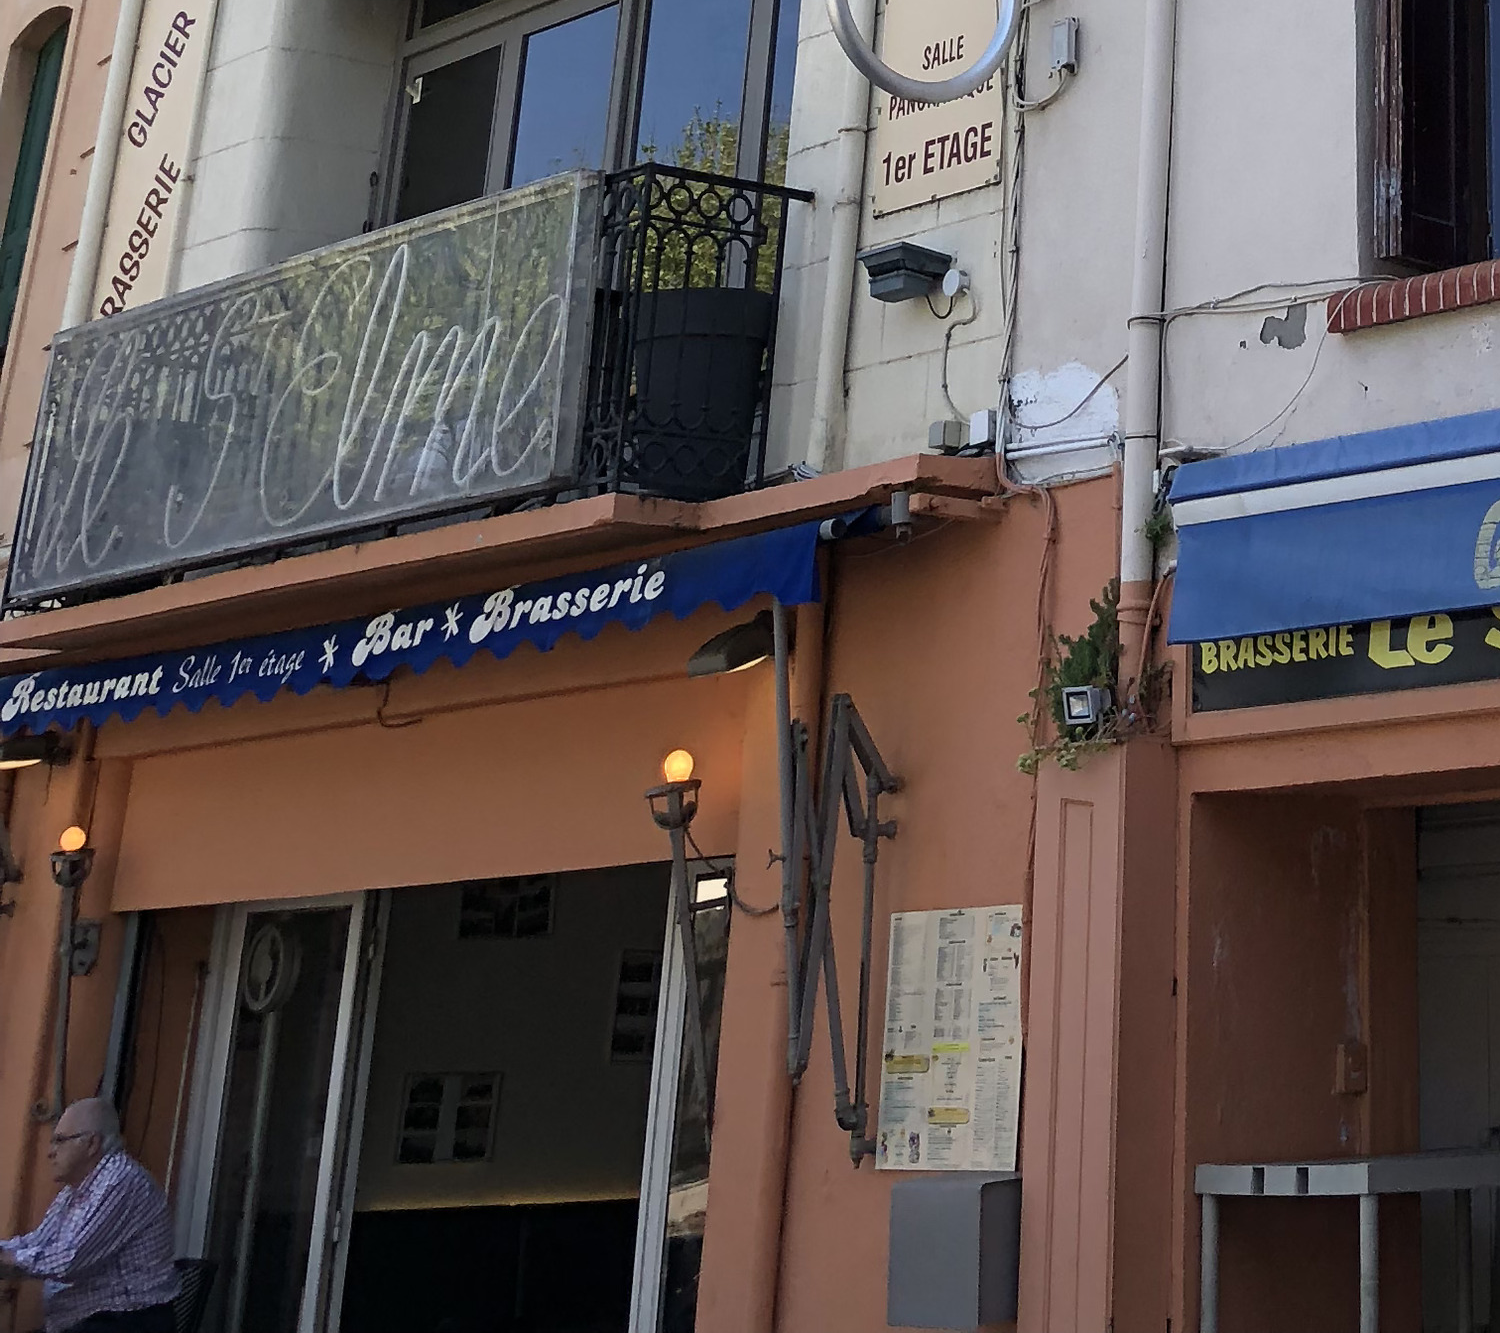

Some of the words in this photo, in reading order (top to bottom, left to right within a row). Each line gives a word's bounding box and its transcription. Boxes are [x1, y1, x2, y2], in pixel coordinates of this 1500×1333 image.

[126, 9, 196, 149] GLACIER
[921, 34, 965, 71] SALLE
[882, 151, 917, 187] 1er
[922, 121, 994, 176] ETAGE
[100, 153, 181, 318] RASSERIE
[1, 664, 164, 723] Restaurant
[172, 654, 222, 694] Salle
[228, 650, 252, 684] 1er
[258, 649, 306, 685] étage
[351, 608, 434, 667] Bar
[469, 562, 666, 644] Brasserie
[1200, 623, 1355, 675] BRASSERIE
[1367, 612, 1454, 670] Le
